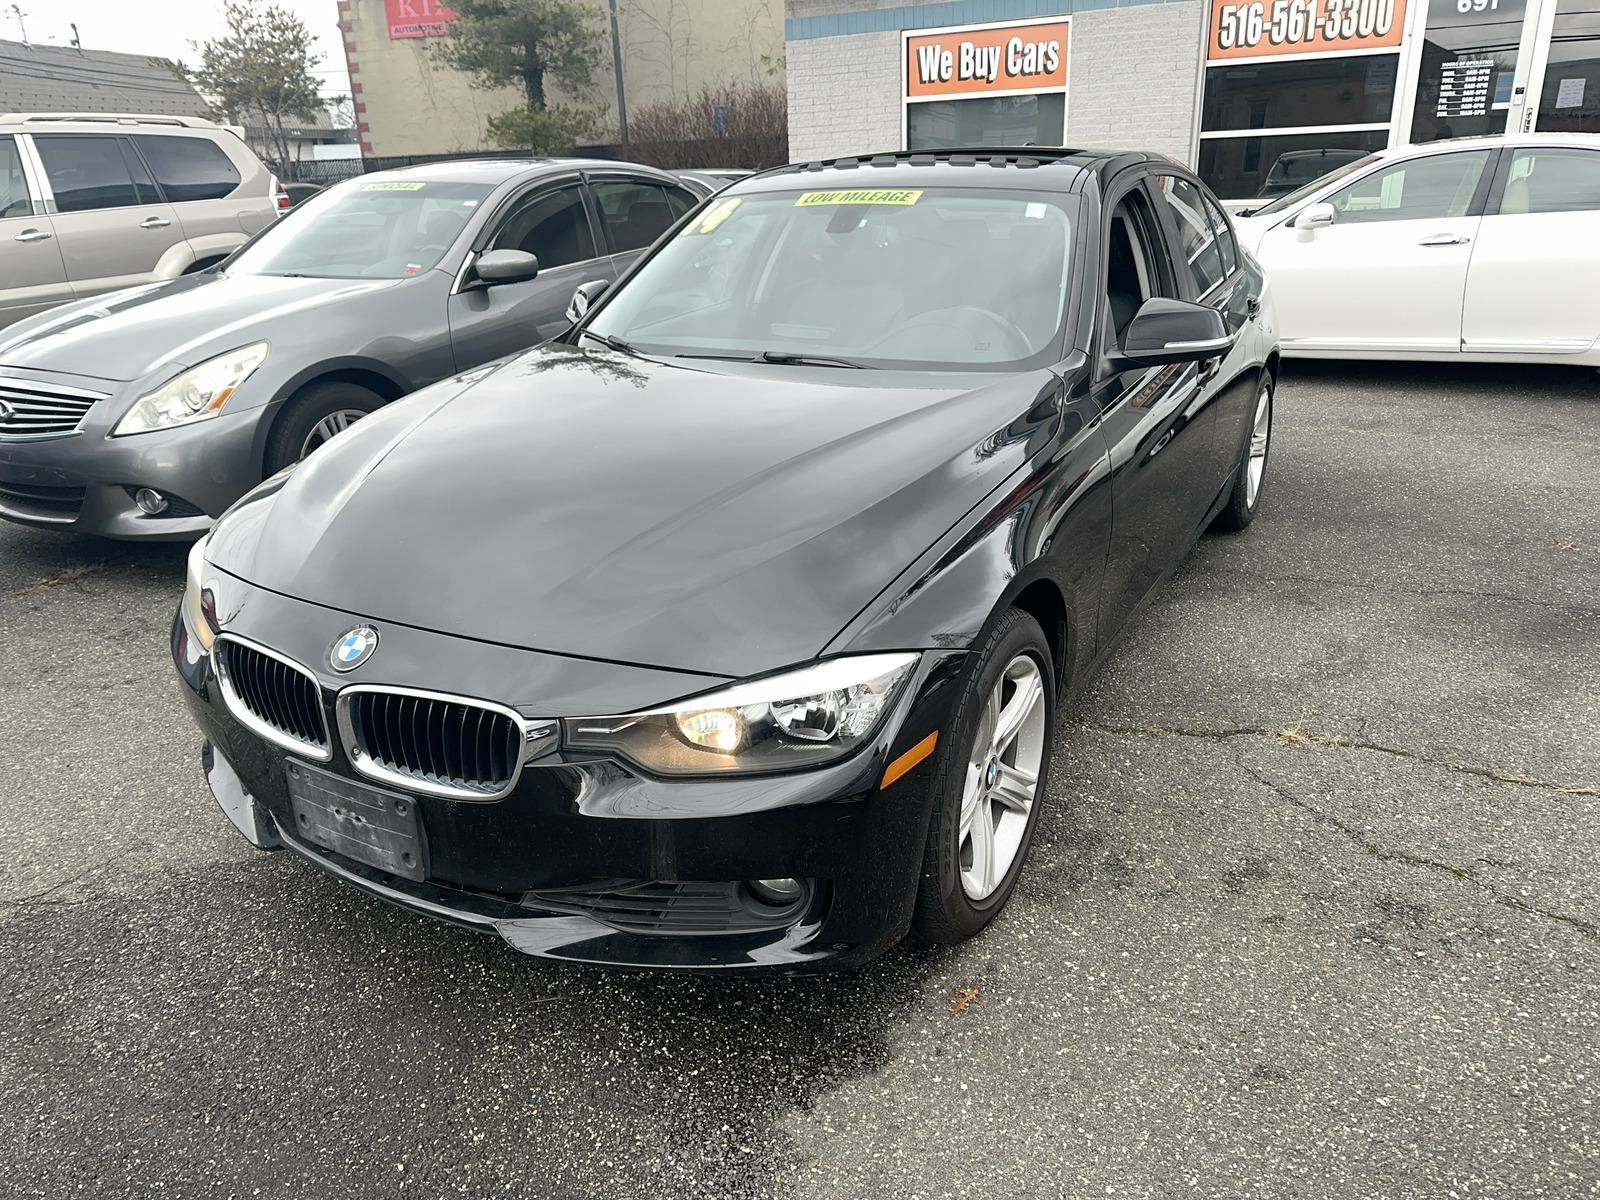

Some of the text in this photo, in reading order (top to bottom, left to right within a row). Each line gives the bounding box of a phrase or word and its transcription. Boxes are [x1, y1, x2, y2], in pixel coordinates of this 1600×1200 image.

[1218, 0, 1395, 49] 516-561-3300
[917, 36, 1060, 84] We Buy Cars
[802, 191, 914, 204] LOW MILEAGE
